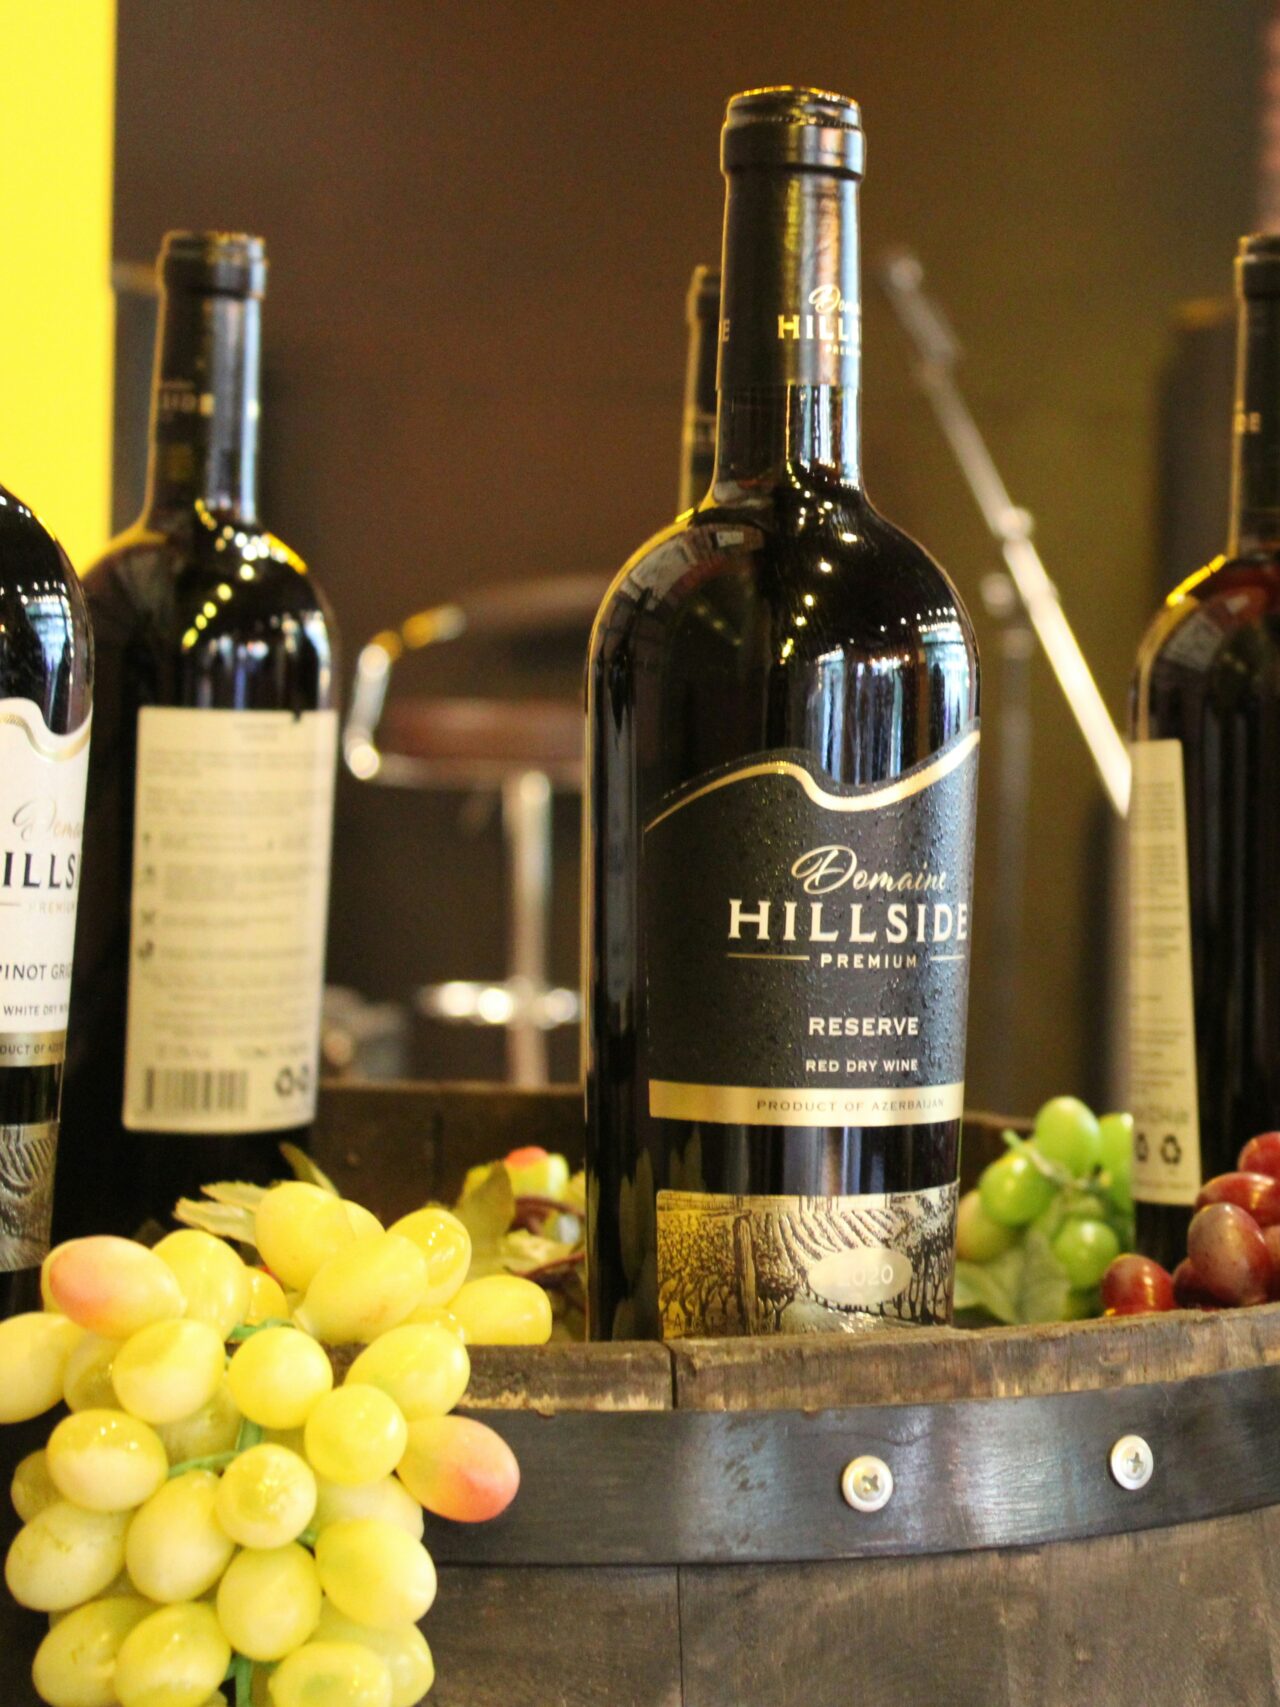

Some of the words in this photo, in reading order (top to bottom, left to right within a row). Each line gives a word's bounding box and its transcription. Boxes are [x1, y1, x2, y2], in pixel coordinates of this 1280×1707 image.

[790, 844, 947, 895] Domaine
[728, 899, 968, 944] HILLSIDE
[820, 953, 917, 968] PREMIUM
[3, 1004, 39, 1017] WHITE
[808, 1016, 919, 1037] RESERVE
[805, 1059, 840, 1073] RED
[846, 1059, 878, 1073] DRY
[883, 1058, 918, 1073] WINE
[756, 1100, 836, 1112] PRODUCT
[844, 1101, 861, 1112] OF
